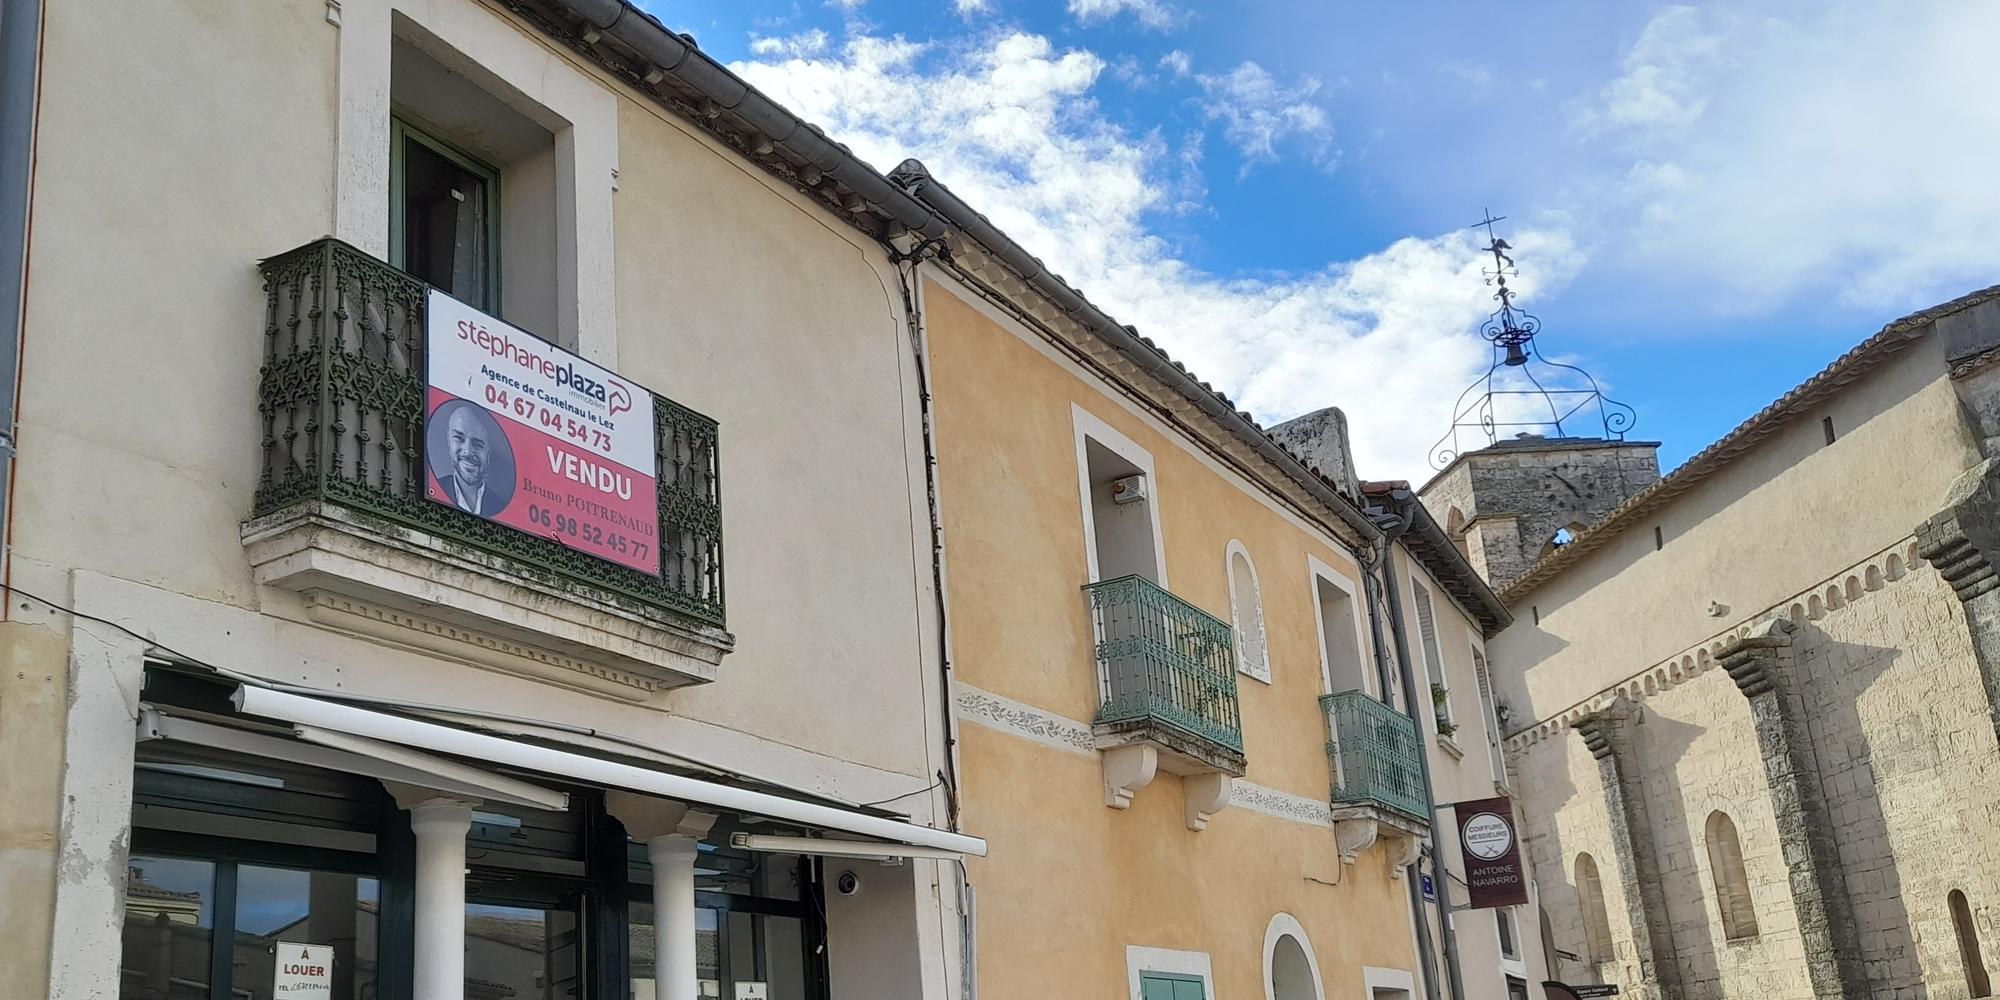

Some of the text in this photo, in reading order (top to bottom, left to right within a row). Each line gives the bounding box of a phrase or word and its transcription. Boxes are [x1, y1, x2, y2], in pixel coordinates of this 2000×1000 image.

[481, 364, 614, 431] Agence de Castelnau le Lez
[485, 384, 611, 452] 04 67 04 54 73
[546, 444, 632, 500] VENDU
[523, 477, 653, 536] Bruno POITRENAUD
[528, 504, 649, 560] 06 98 52 45 77
[1467, 830, 1507, 840] MESSIEURS
[1469, 823, 1503, 833] COIFFURE
[1472, 875, 1518, 887] NAVARRO
[1473, 864, 1514, 876] ANTOINE
[284, 964, 324, 977] LOUER
